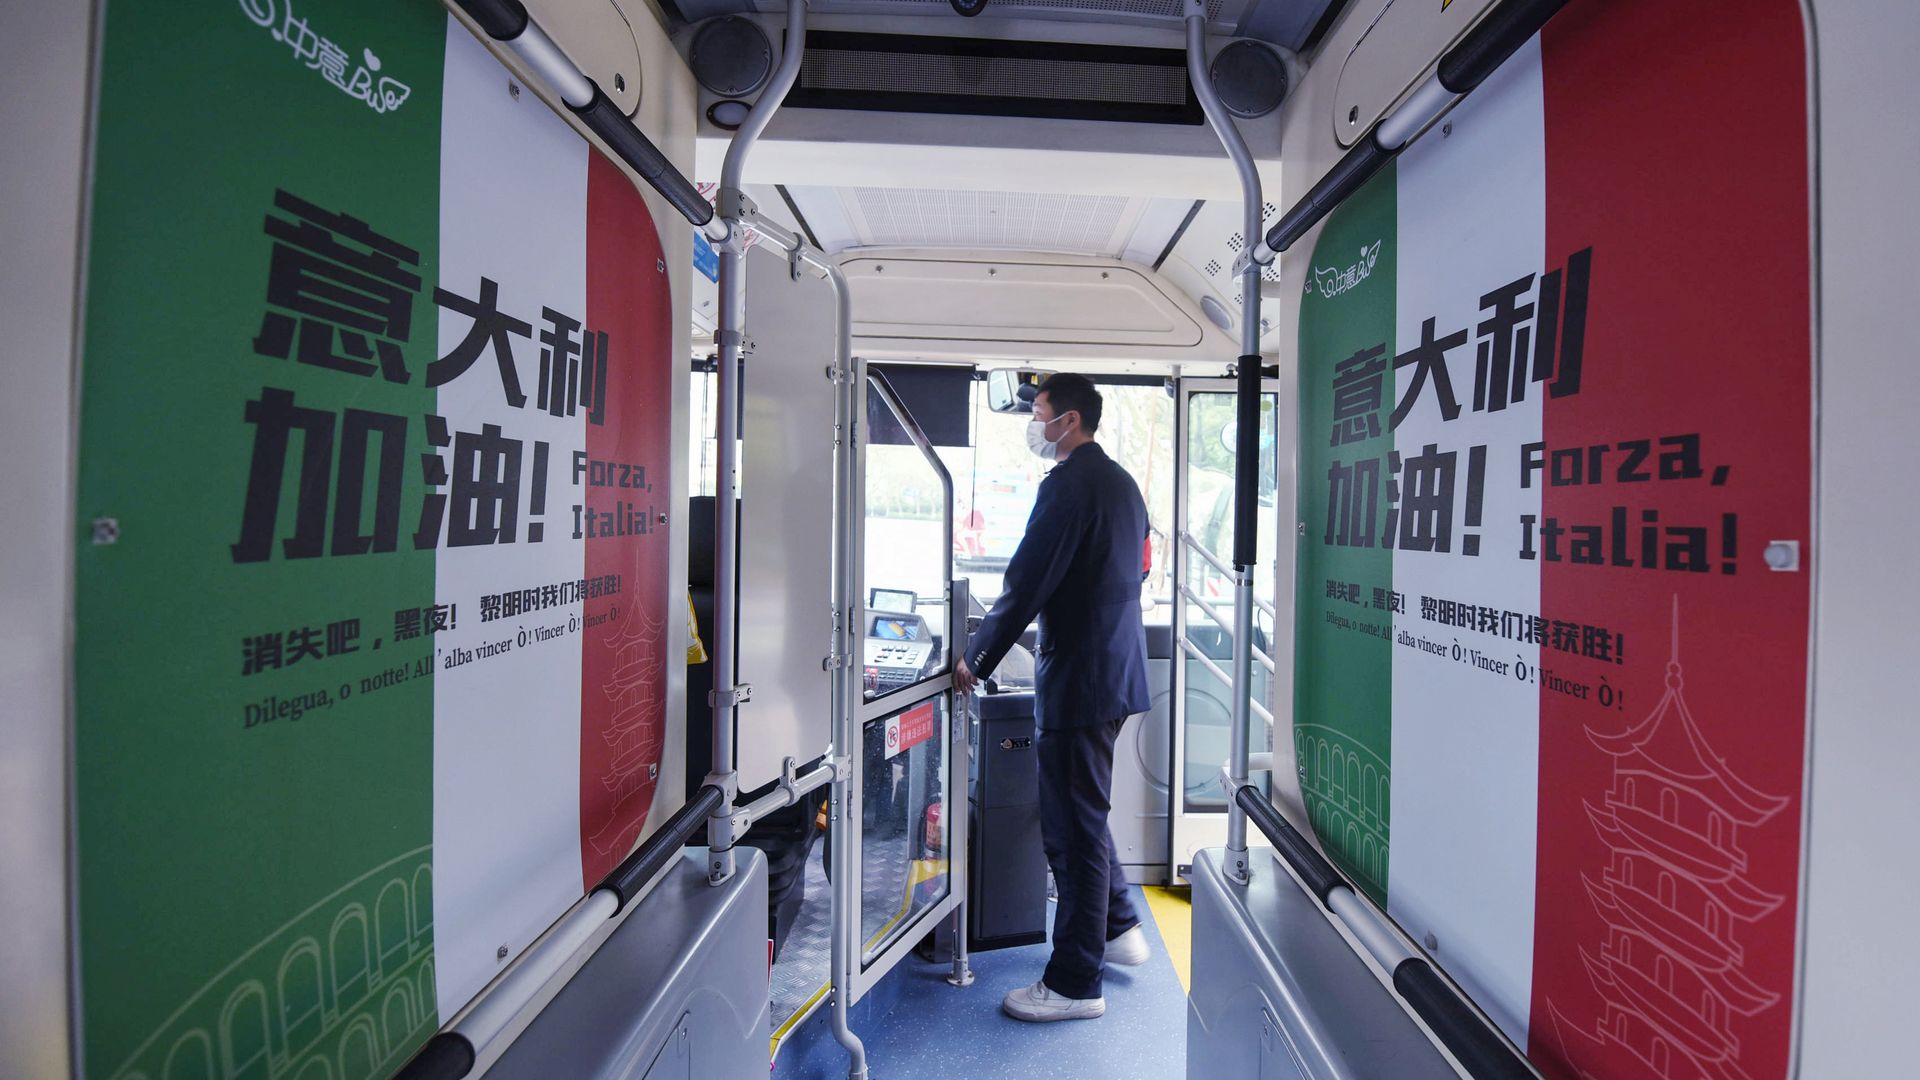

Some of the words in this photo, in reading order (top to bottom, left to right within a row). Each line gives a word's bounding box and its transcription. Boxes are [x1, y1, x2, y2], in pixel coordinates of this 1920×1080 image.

[251, 187, 609, 426] 意大利
[1329, 245, 1593, 448] 意大利
[230, 386, 550, 564] 加油！
[572, 449, 653, 493] Forza,
[1324, 443, 1487, 557] 加油！
[1519, 432, 1731, 489] Forza,
[571, 500, 654, 540] Italia!
[1519, 506, 1738, 576] Italia!
[243, 688, 334, 729] Dilegua,
[339, 683, 351, 700] o
[360, 662, 409, 694] notte!
[475, 638, 512, 660] vincer
[534, 624, 565, 643] Vincer
[582, 612, 607, 628] Vincer
[1326, 611, 1351, 631] Dilegua,
[1359, 623, 1380, 638] notte!
[1417, 635, 1448, 657] vincer
[1470, 649, 1509, 676] Vincer
[1538, 667, 1590, 701] Vincer
